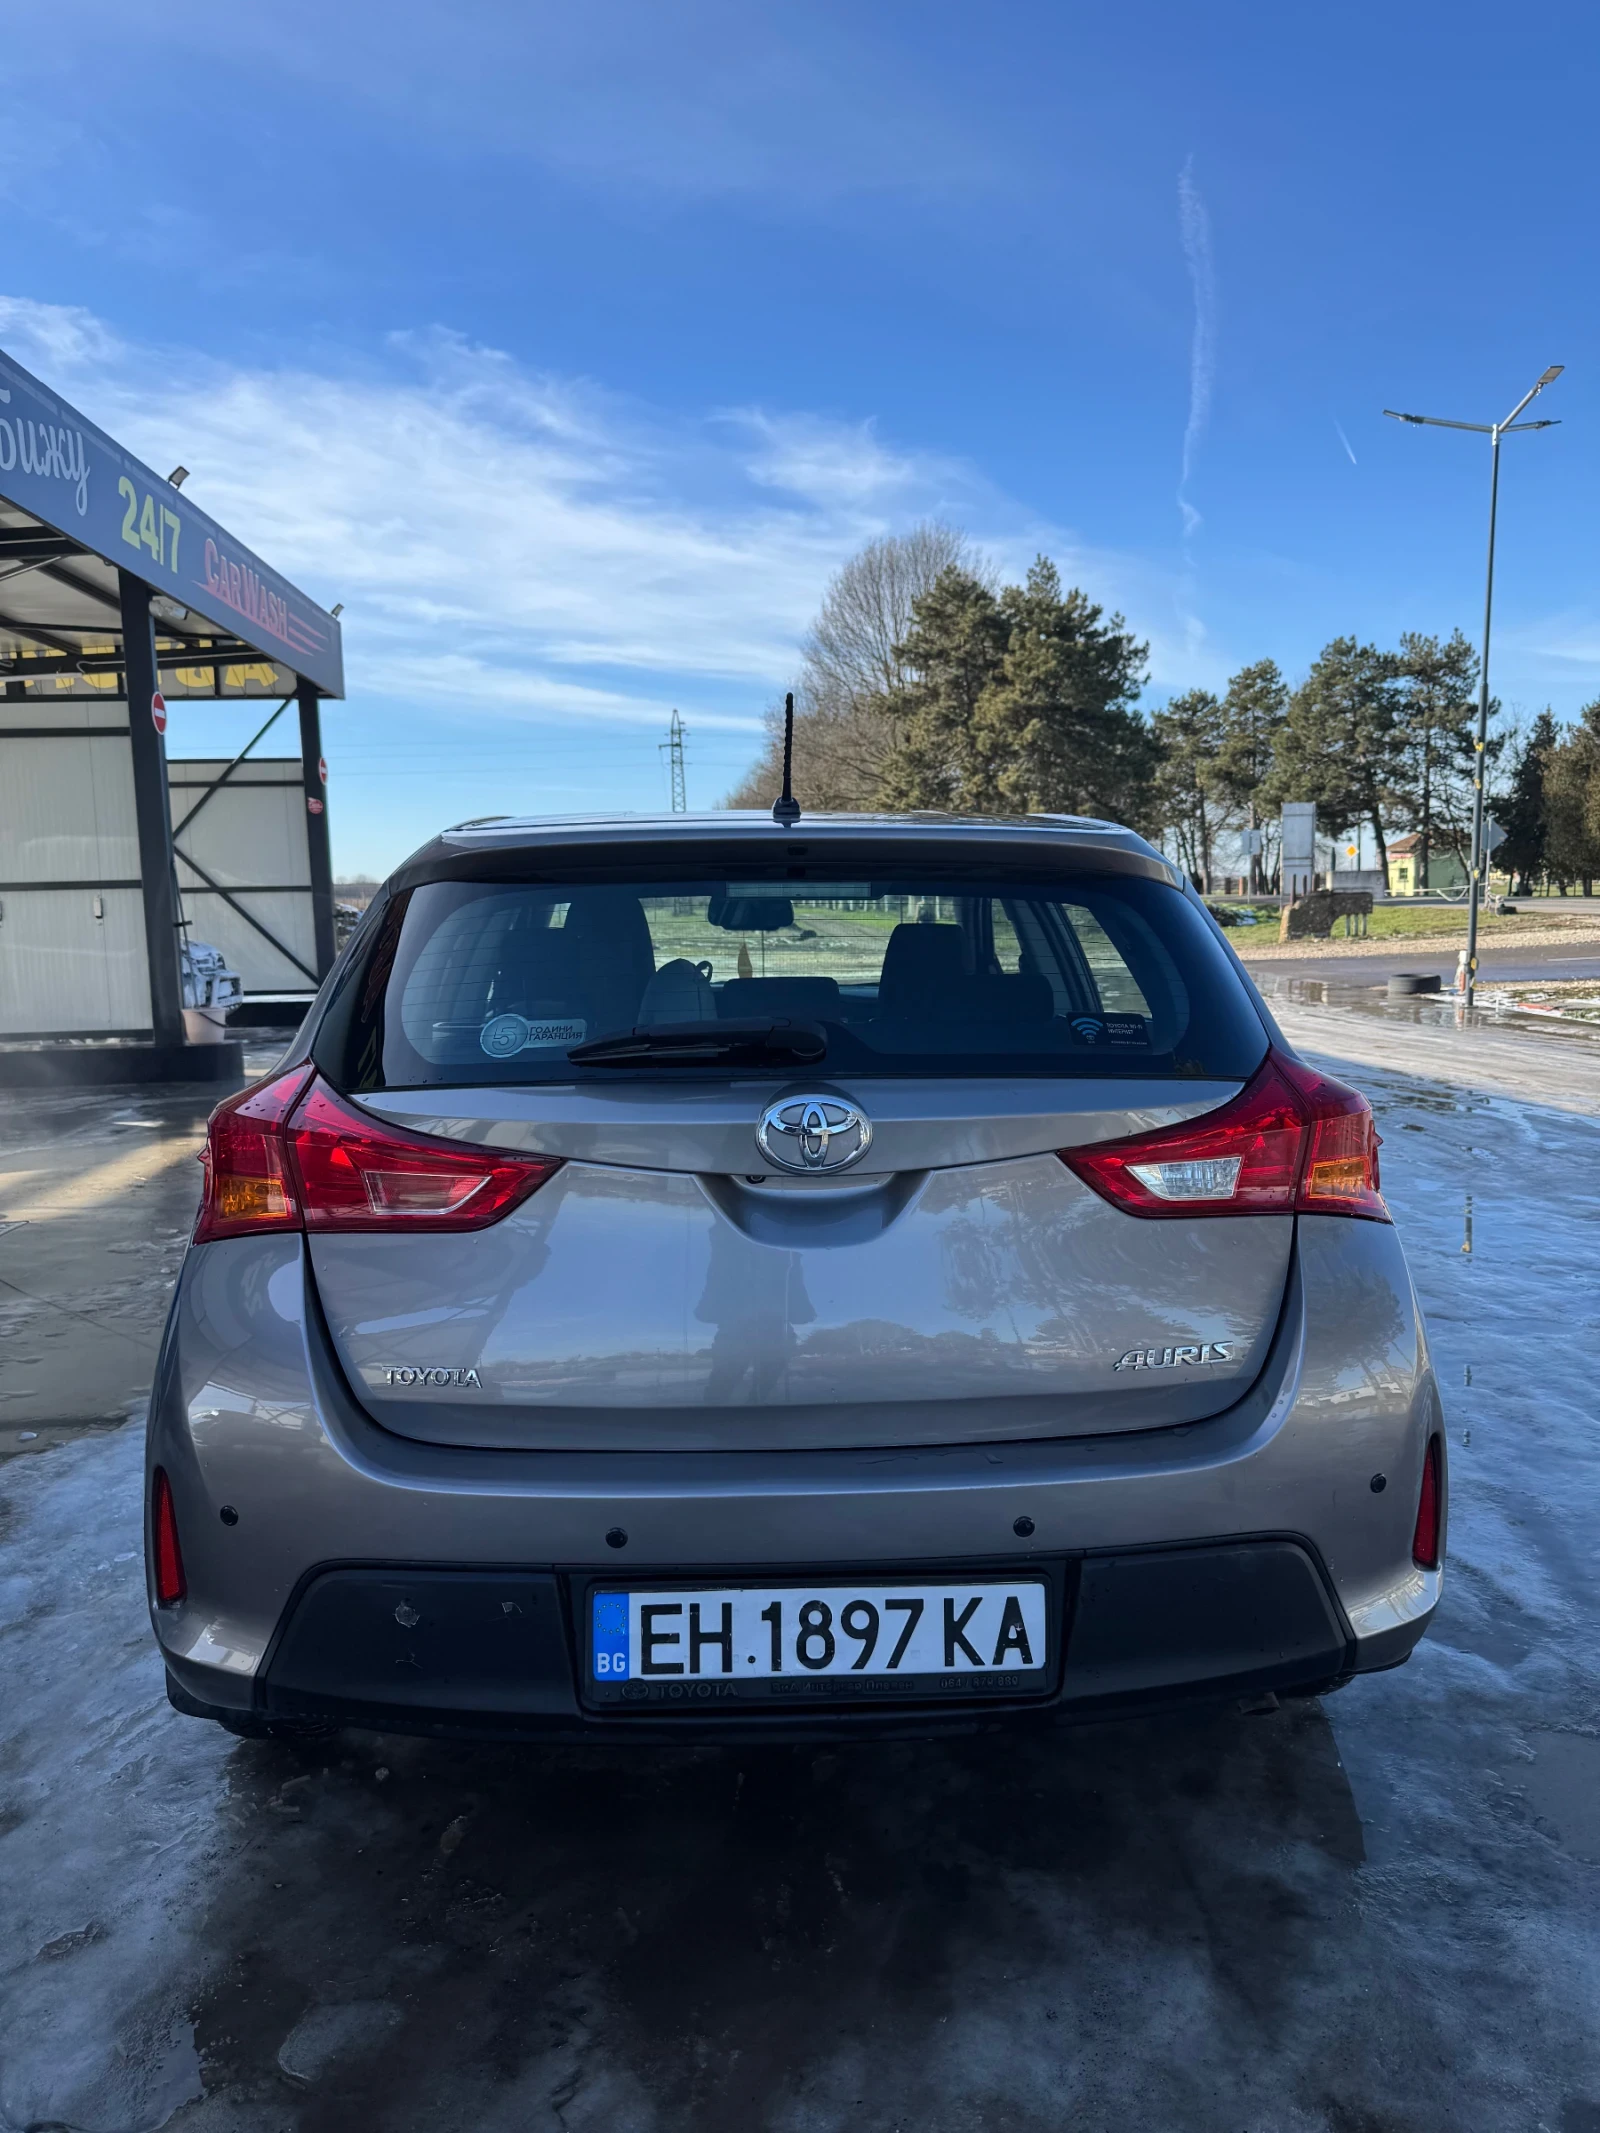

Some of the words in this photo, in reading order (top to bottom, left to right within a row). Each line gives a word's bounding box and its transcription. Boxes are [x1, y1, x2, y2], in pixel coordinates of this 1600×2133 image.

[492, 1021, 518, 1051] 5
[528, 1032, 583, 1041] ГАРАНЦИЯ
[530, 1025, 574, 1034] ГОДИНИ
[1112, 1340, 1235, 1371] AURIS
[381, 1365, 483, 1389] TOYOTA
[640, 1602, 733, 1675] EH
[761, 1598, 925, 1673] 1897
[942, 1595, 1034, 1668] KA
[597, 1652, 626, 1674] BG
[656, 1682, 739, 1699] TOYOTA
[940, 1677, 962, 1689] 064
